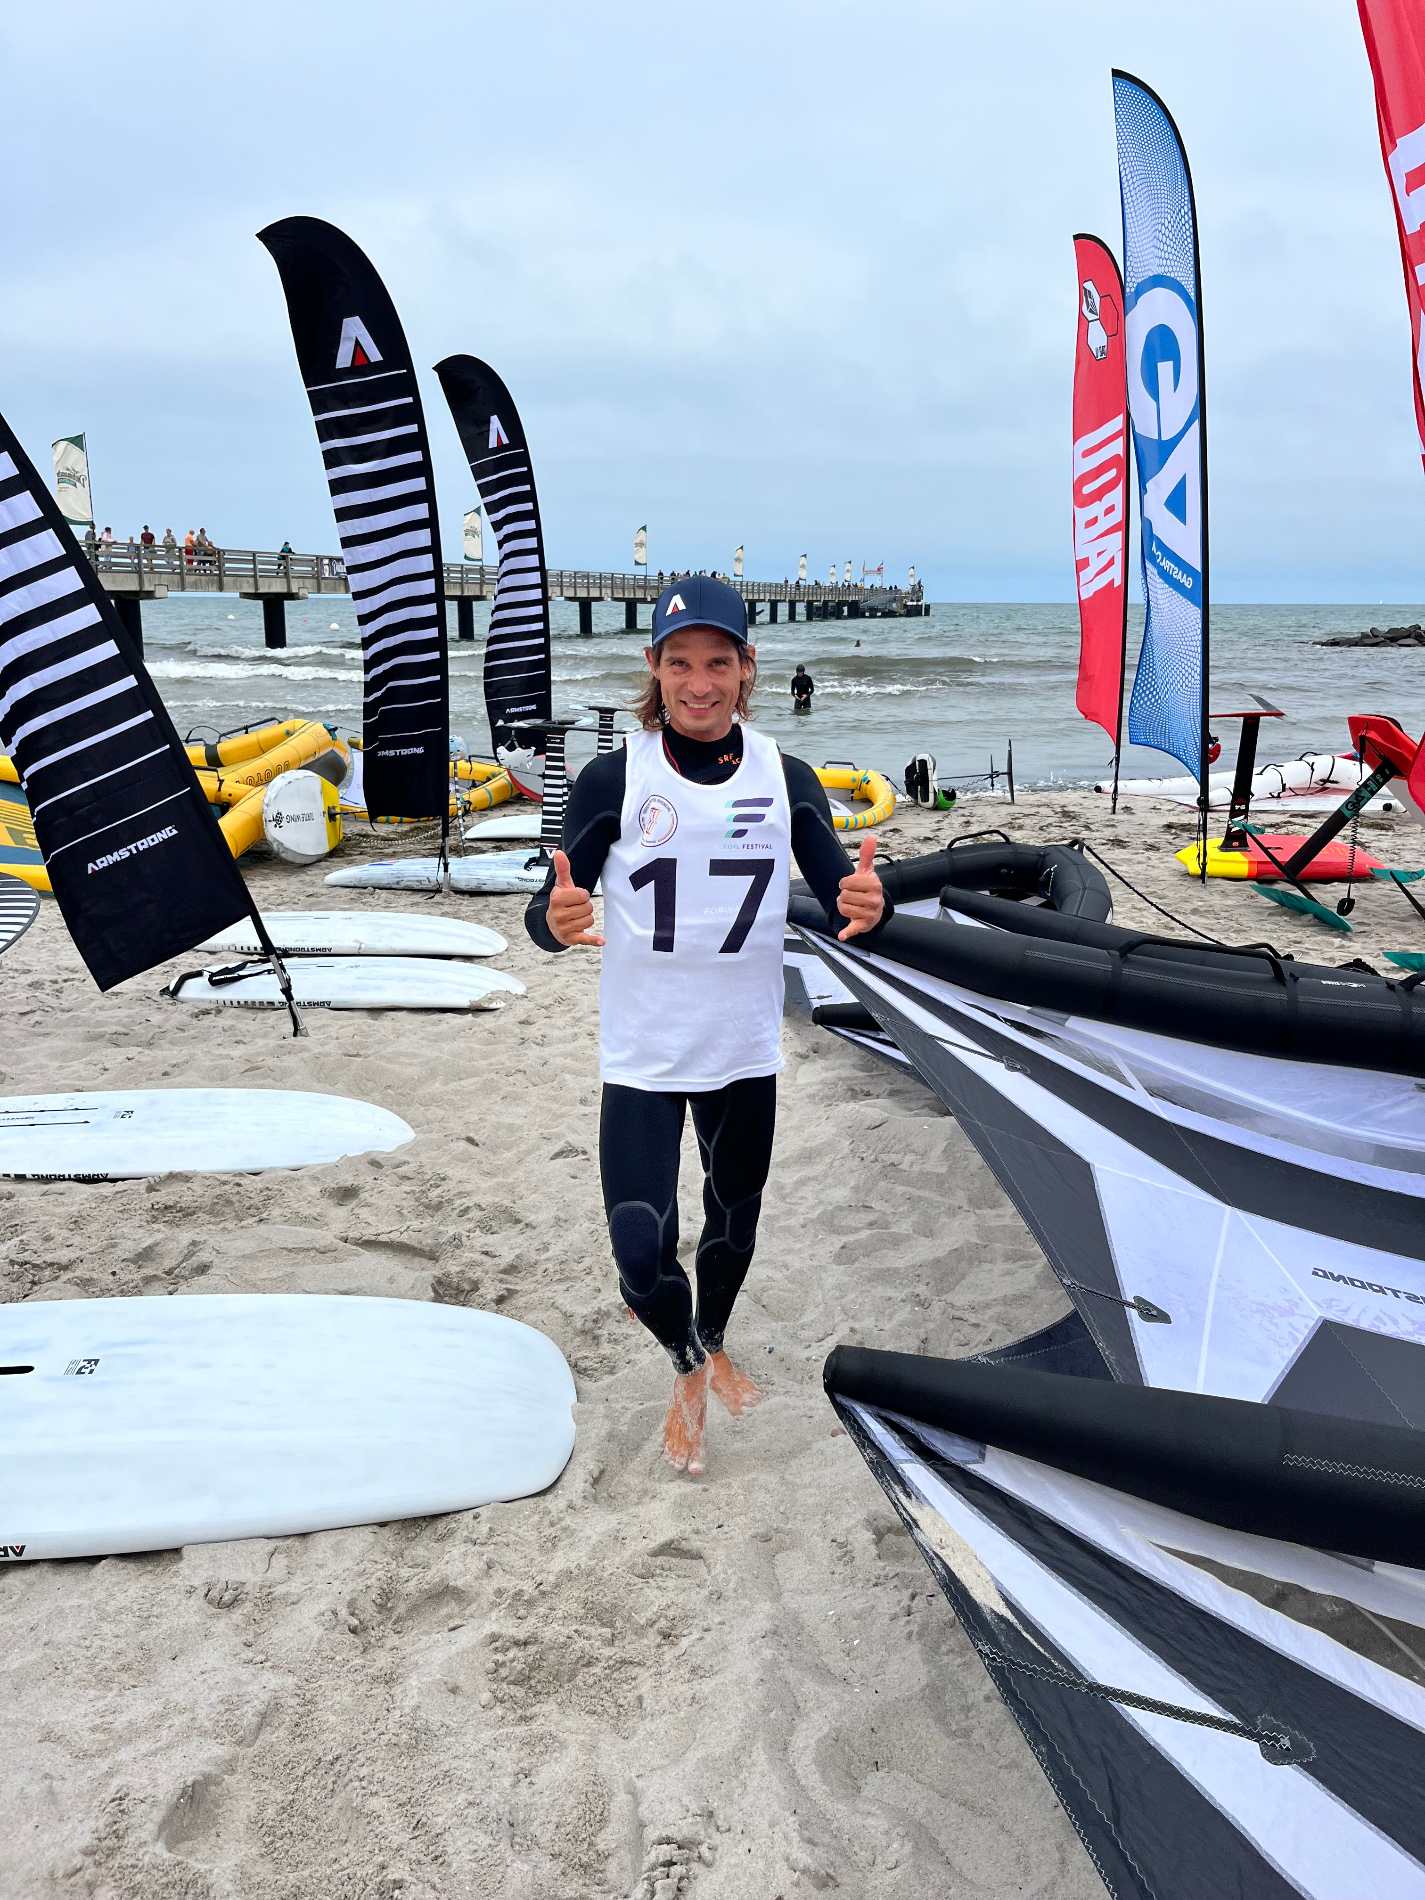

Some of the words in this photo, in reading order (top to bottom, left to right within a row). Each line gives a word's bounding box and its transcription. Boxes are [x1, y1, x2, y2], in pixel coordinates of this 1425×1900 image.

[87, 825, 179, 875] ARMSTRONG
[628, 857, 776, 954] 17
[31, 1173, 109, 1181] ARMSTRONG
